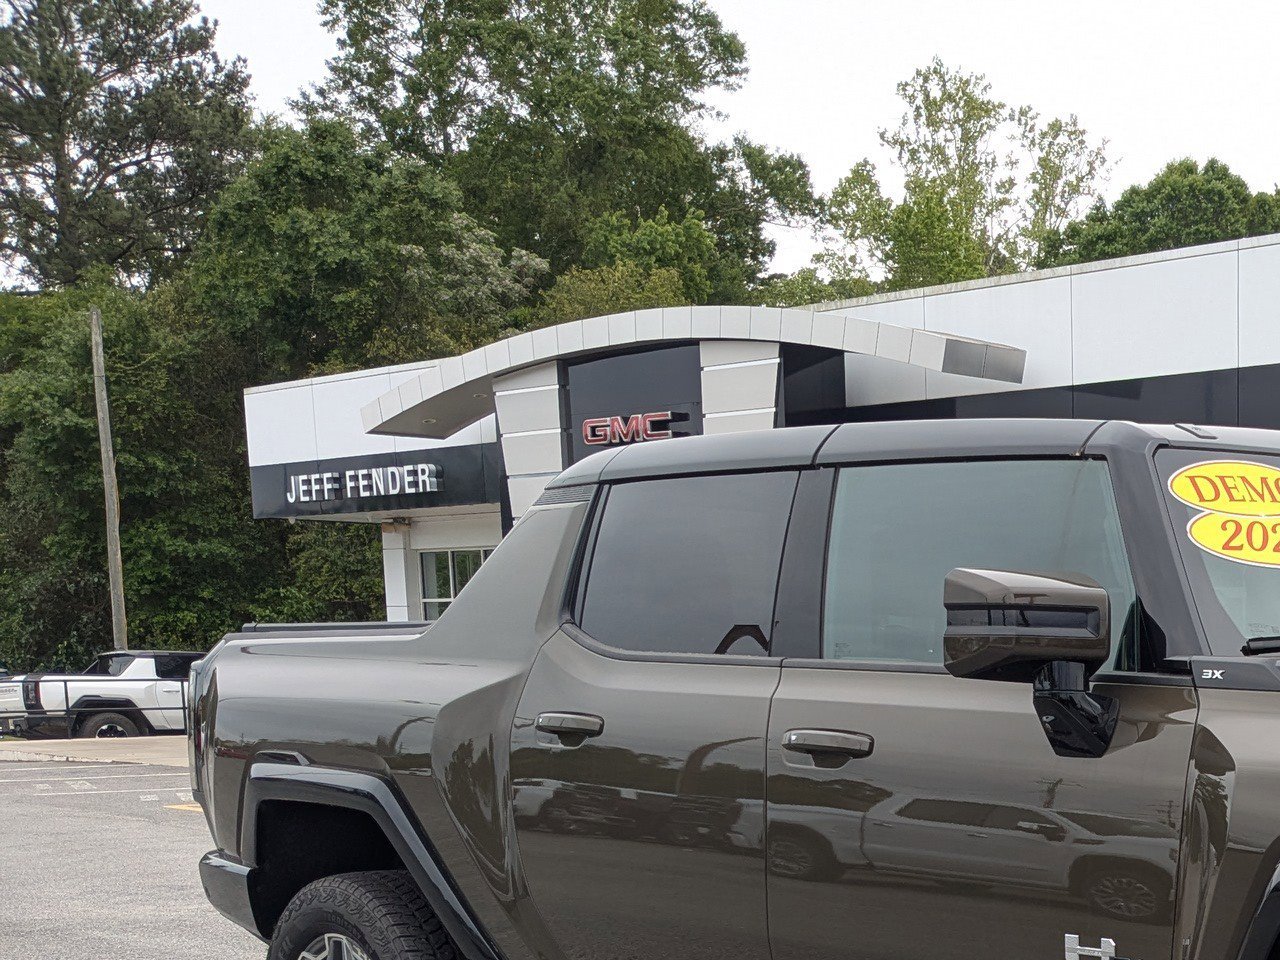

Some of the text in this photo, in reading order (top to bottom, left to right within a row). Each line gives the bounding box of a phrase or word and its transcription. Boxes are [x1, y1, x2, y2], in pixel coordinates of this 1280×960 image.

[583, 411, 673, 445] GMC
[286, 463, 434, 503] JEFF FENDER
[1201, 669, 1226, 680] 3X
